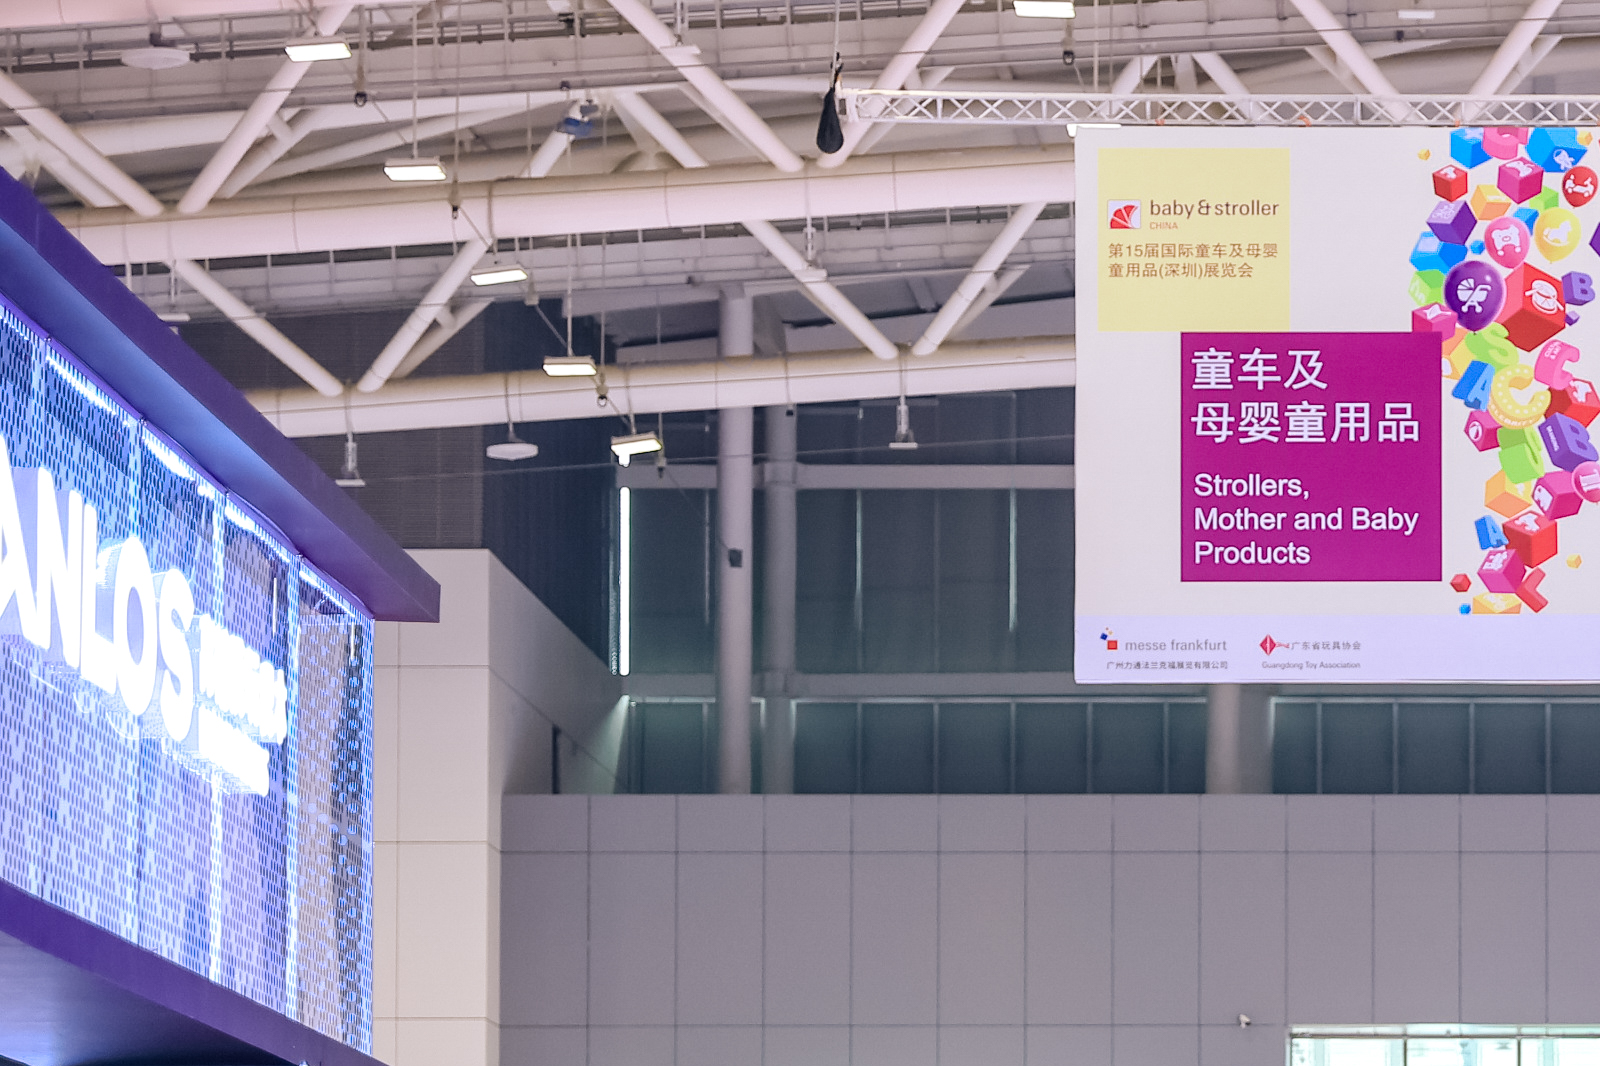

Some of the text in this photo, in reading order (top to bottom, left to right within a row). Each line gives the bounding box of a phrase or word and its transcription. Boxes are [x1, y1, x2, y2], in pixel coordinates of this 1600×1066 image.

[1150, 199, 1280, 219] baby & stroller
[1149, 222, 1179, 230] CHINA
[1108, 242, 1278, 259] 第15届国际童车及母婴
[1108, 262, 1254, 279] 童用品(深圳)展览会
[1190, 346, 1328, 391] 童车及
[1190, 400, 1421, 444] 母婴童用品
[1193, 472, 1311, 500] Strollers,
[1194, 507, 1419, 537] Mother and Baby
[1194, 541, 1311, 565] Products
[1125, 639, 1227, 651] messe frankfurt
[1262, 661, 1361, 670] Guangdong Toy Association
